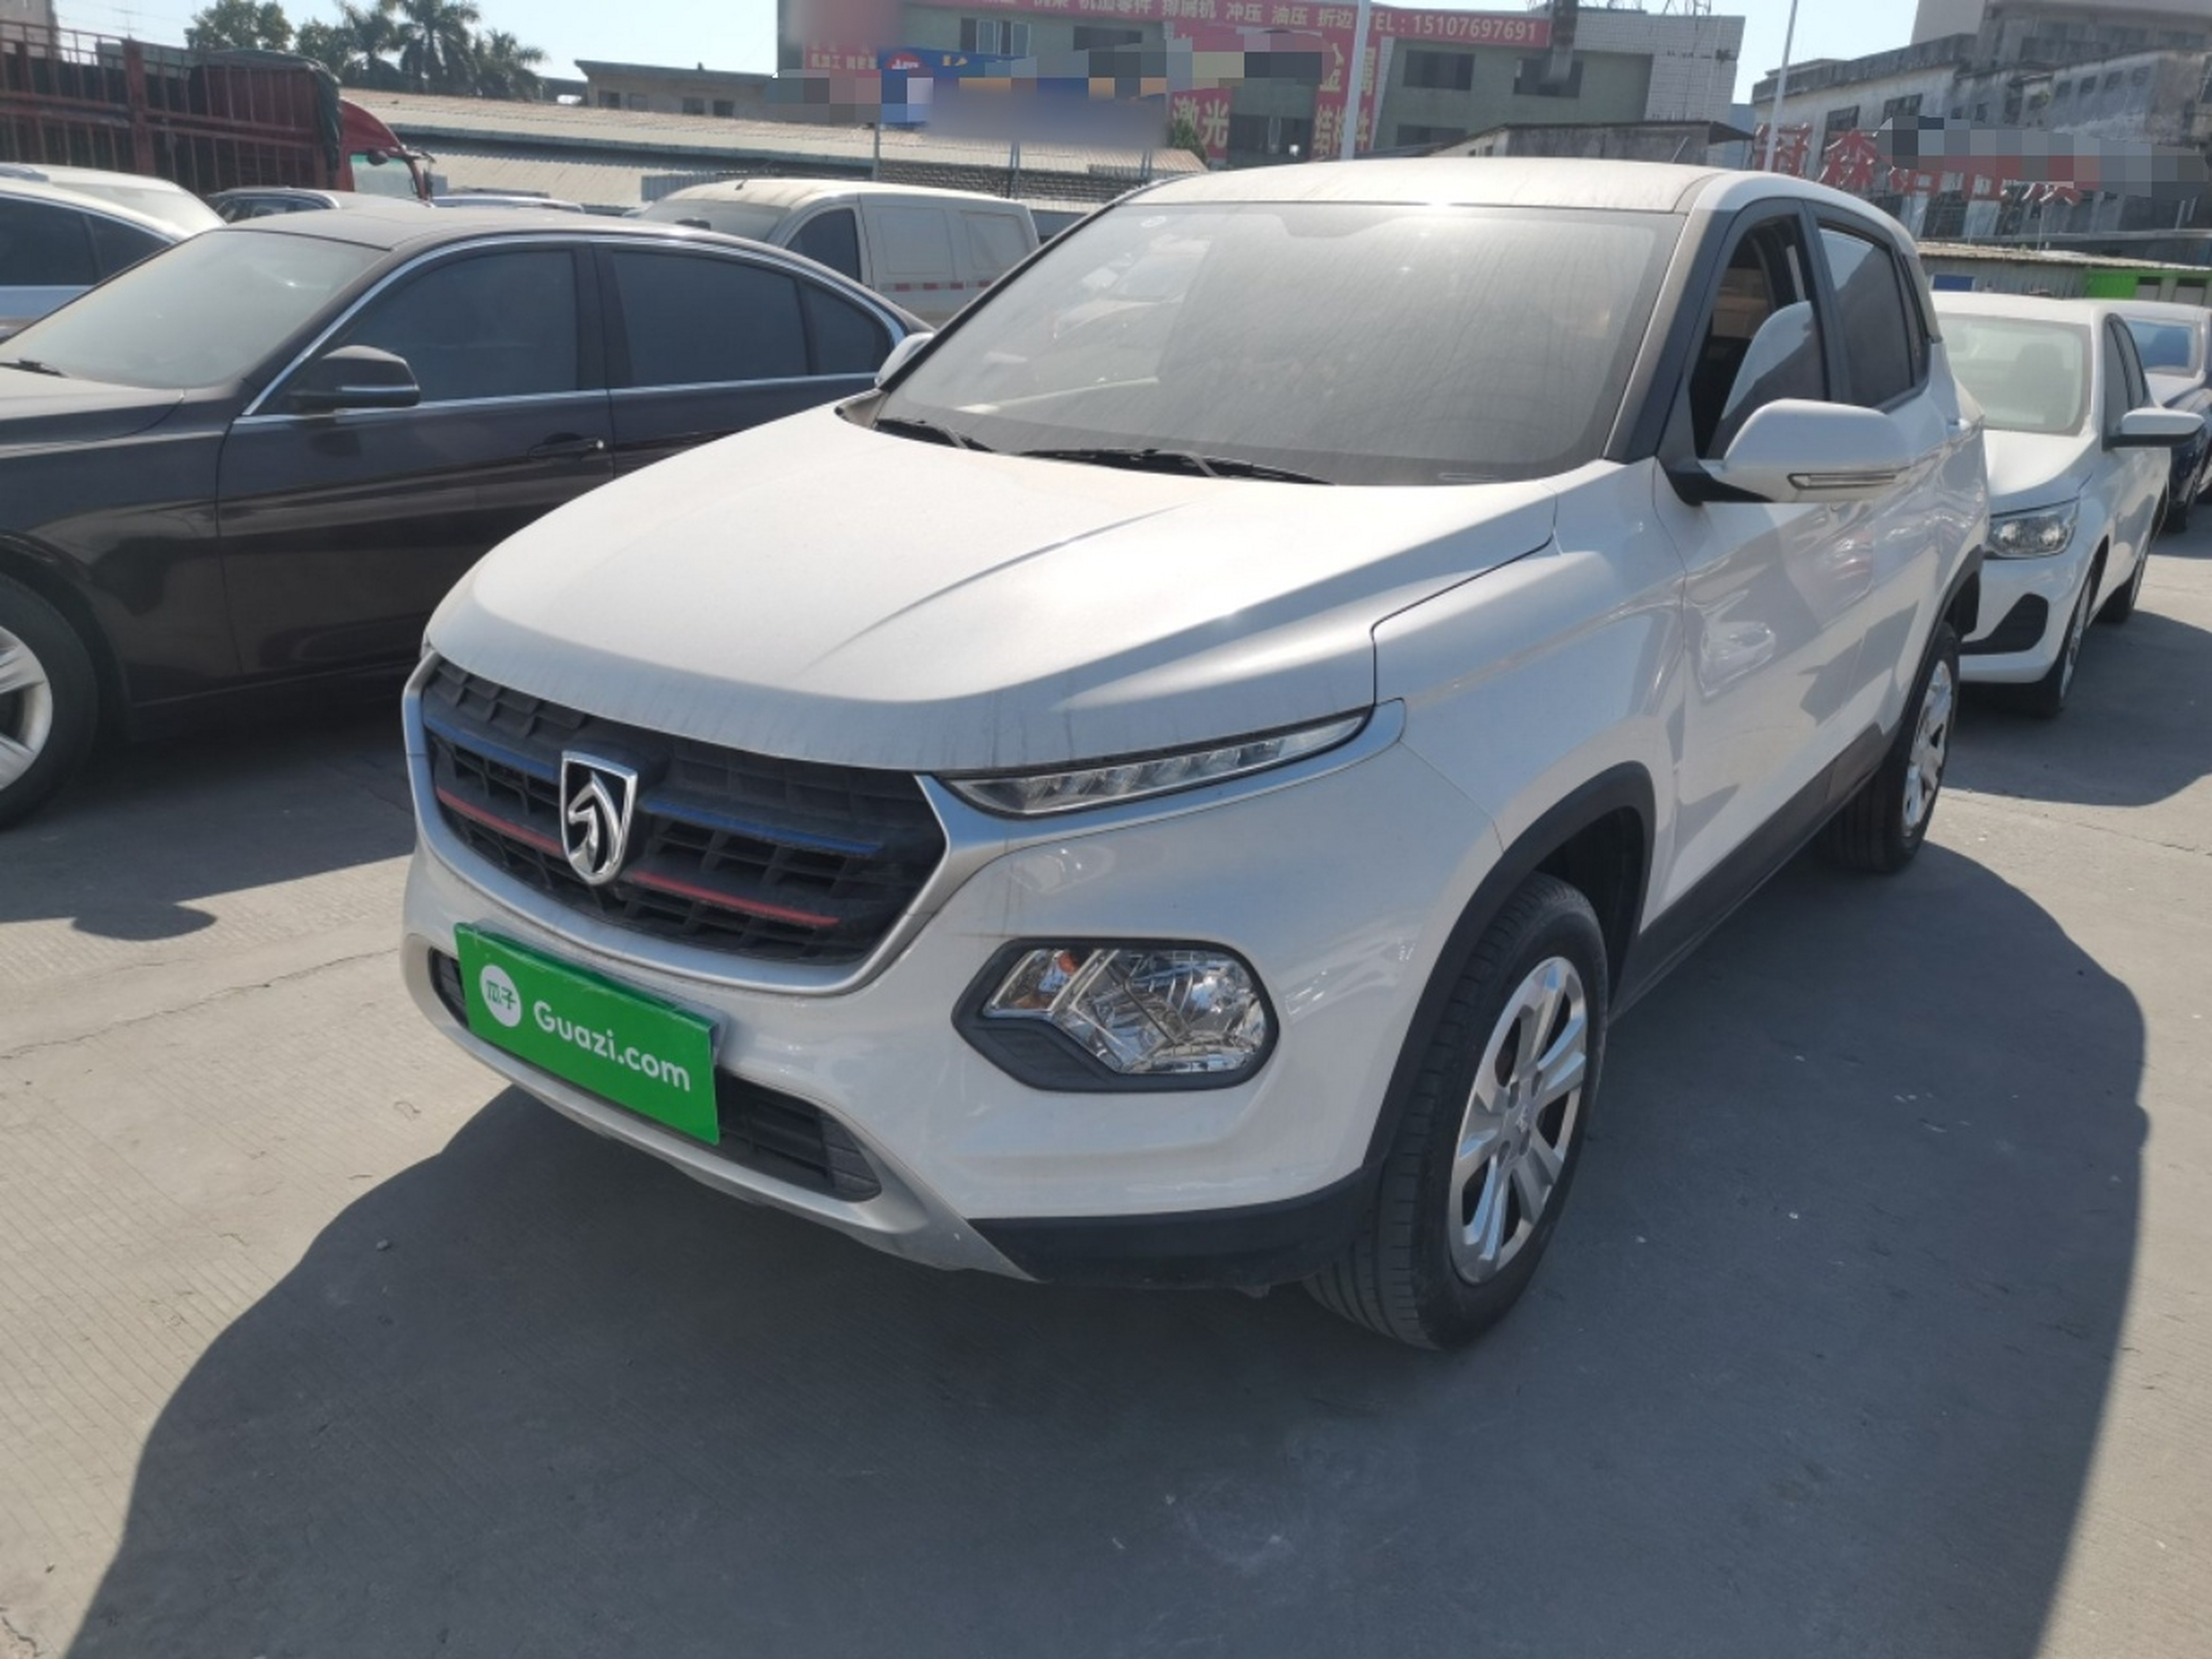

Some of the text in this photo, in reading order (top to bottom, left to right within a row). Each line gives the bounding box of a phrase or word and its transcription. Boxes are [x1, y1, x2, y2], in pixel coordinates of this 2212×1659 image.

[1226, 2, 1263, 22] 冲压
[1271, 5, 1309, 25] 油压
[1317, 8, 1353, 28] 折边
[1415, 14, 1536, 40] 15107697691
[487, 980, 516, 1010] 瓜子
[533, 1001, 691, 1092] Guazi.com
